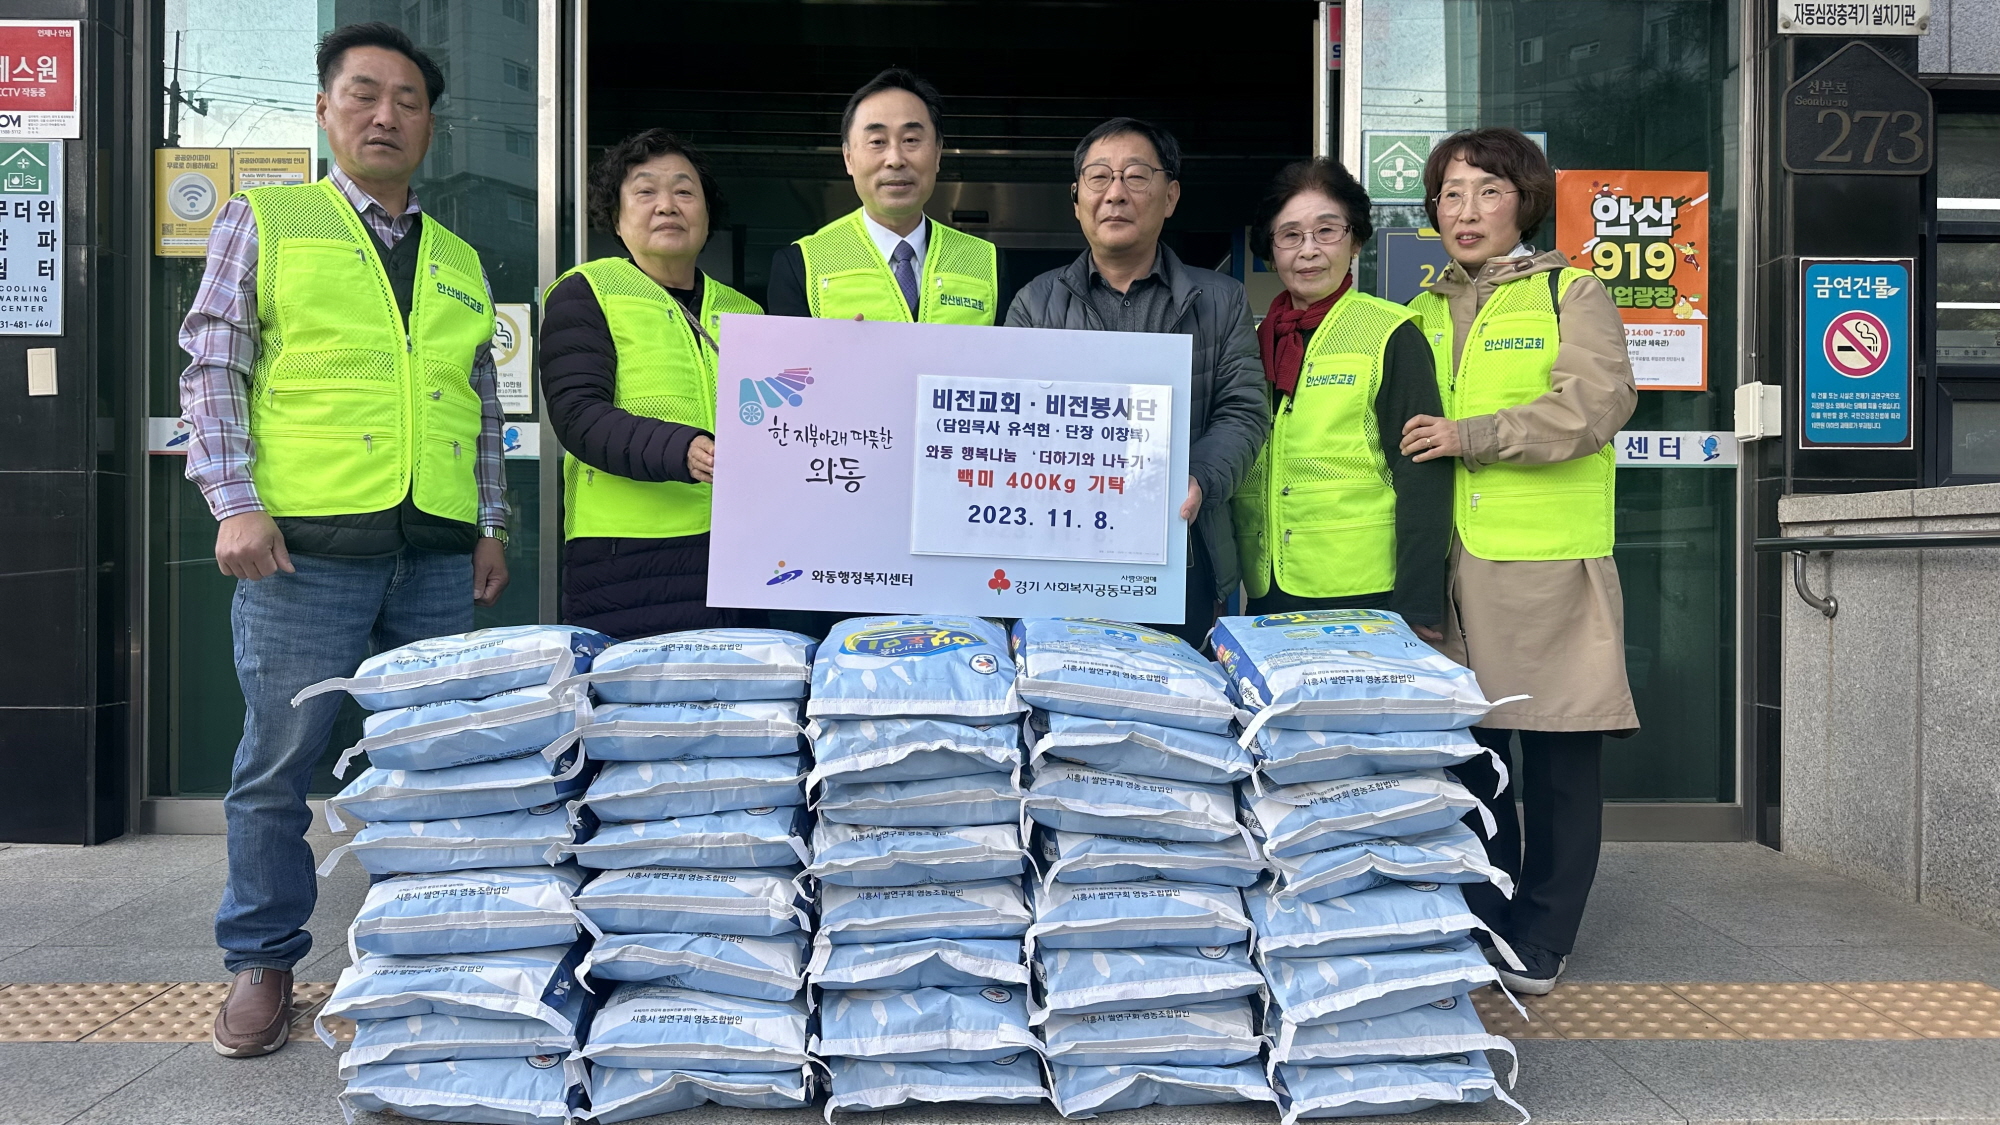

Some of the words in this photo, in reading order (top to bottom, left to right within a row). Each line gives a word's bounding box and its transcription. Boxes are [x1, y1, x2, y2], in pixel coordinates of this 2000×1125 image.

[1794, 3, 1869, 26] 자동심장충격기
[1872, 4, 1916, 26] 설치기관
[37, 29, 57, 37] 언제나
[58, 29, 72, 37] 안심
[0, 88, 20, 97] CTV
[22, 88, 46, 97] 작동중
[1807, 80, 1848, 95] 선부로
[1794, 96, 1848, 108] Seonbu-ro
[1814, 109, 1924, 164] 273
[1592, 196, 1677, 237] 안산
[1593, 241, 1676, 281] 919
[1813, 276, 1892, 299] 금연건물
[436, 282, 484, 315] 안산비전교회
[940, 293, 985, 312] 안산비전교회
[1606, 286, 1676, 308] 업광장
[1632, 329, 1654, 337] 14:00
[1663, 329, 1685, 337] 17:00
[1484, 338, 1545, 352] 안산비전교회
[1305, 374, 1356, 388] 안산비전교회
[932, 388, 1021, 415] 비전교회
[1046, 394, 1158, 422] 비전봉사단
[768, 415, 790, 447] 한
[793, 423, 847, 448] 지붕아래
[850, 426, 893, 450] 따뜻한
[936, 418, 1001, 436] (담임목사
[1007, 421, 1050, 438] 유석현
[1065, 424, 1094, 440] 단장
[925, 445, 953, 460] 와동
[961, 446, 1017, 463] 행복나눔
[805, 457, 867, 493] 와동
[957, 469, 994, 488] 백미
[1006, 472, 1076, 493] 400Kg
[1088, 475, 1126, 495] 기탁
[968, 504, 1034, 526] 2023.
[1048, 508, 1081, 528] 11.
[1094, 511, 1114, 530] 8.
[811, 570, 913, 587] 와동행정복지센터
[1121, 574, 1157, 584] 사랑의열매
[1015, 580, 1040, 595] 경기
[1043, 581, 1157, 598] 사회복지공동모금회
[1062, 663, 1086, 673] 시흥시
[1088, 667, 1120, 677] 쌀연구회
[1122, 671, 1169, 685] 영농조합법인
[1303, 677, 1328, 686] 시흥시
[1329, 675, 1363, 685] 쌀연구회
[1365, 674, 1415, 684] 영농조합법인
[1065, 773, 1089, 784] 시흥시
[1091, 776, 1123, 788] 쌀연구회
[1126, 781, 1173, 794] 영농조합법인
[1351, 779, 1401, 797] 영농조합법인
[850, 832, 874, 843] 시흥시
[875, 830, 905, 841] 쌀연구회
[625, 871, 651, 879] 시흥시
[653, 872, 686, 881] 쌀연구회
[688, 873, 737, 883] 영농조합법인
[395, 892, 420, 902] 시흥시
[423, 888, 457, 899] 쌀연구회
[460, 885, 510, 897] 영농조합법인
[857, 892, 881, 900] 시흥시
[882, 890, 915, 899] 쌀연구회
[916, 889, 964, 897] 영농조합법인
[1071, 893, 1096, 901] 시흥시
[1098, 891, 1130, 900] 쌀연구회
[1132, 889, 1181, 898] 영농조합법인
[630, 1015, 656, 1023] 시흥시
[658, 1015, 692, 1024] 쌀연구회
[694, 1015, 743, 1025] 영농조합법인
[1082, 1015, 1105, 1024] 시흥시
[1107, 1013, 1140, 1022] 쌀연구회
[1142, 1009, 1190, 1020] 영농조합법인
